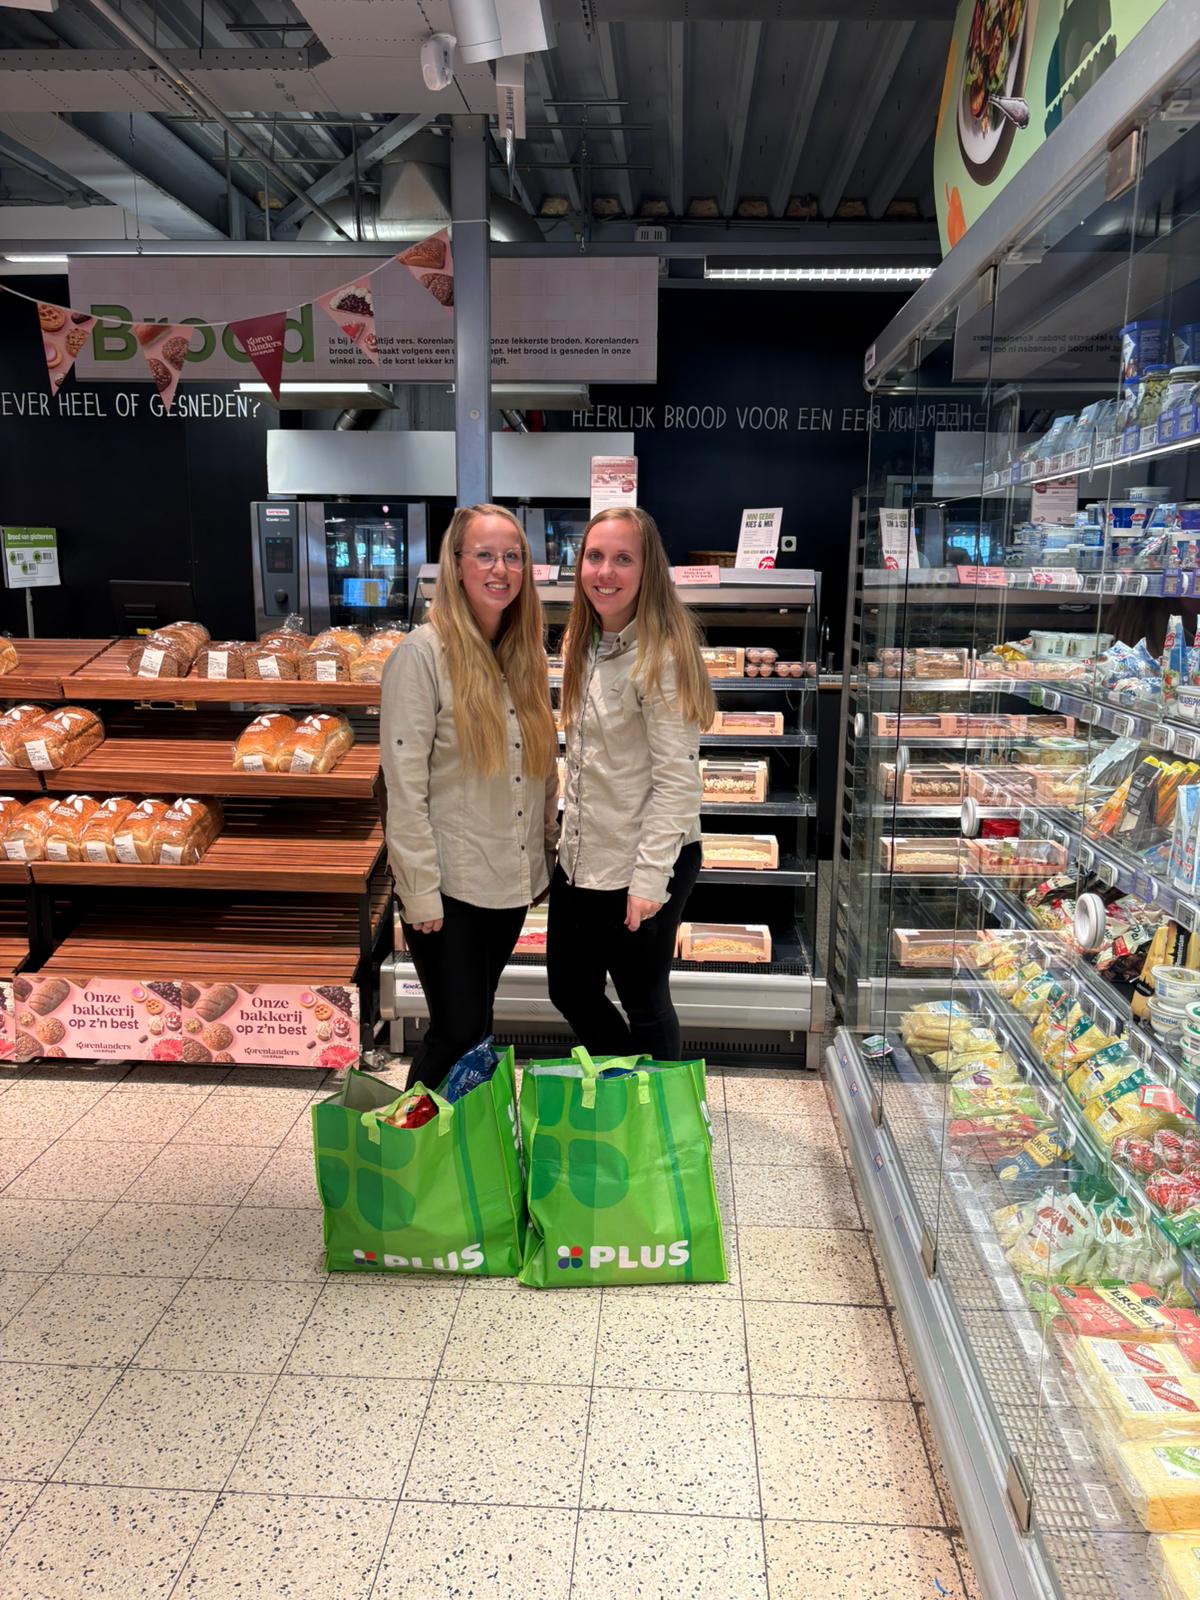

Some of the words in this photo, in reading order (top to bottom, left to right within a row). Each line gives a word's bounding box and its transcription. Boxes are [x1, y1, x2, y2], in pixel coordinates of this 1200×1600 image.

[90, 304, 315, 363] Bood
[329, 337, 335, 345] is
[337, 337, 348, 346] bij
[511, 337, 549, 345] lekkerste
[550, 337, 583, 345] broden.
[584, 337, 639, 345] Korenlanders
[329, 347, 354, 355] brood
[355, 347, 363, 355] is
[401, 347, 433, 356] volgens
[507, 347, 521, 355] Het
[523, 347, 549, 355] brood
[550, 347, 557, 355] is
[559, 347, 600, 356] gesneden
[601, 347, 609, 355] in
[329, 357, 356, 365] winkel
[382, 357, 393, 365] de
[395, 357, 416, 365] korst
[417, 357, 443, 365] lekker
[58, 393, 107, 417] HEEL
[115, 393, 140, 417] OF
[572, 404, 655, 429] HEERLIJK
[664, 405, 726, 429] BROOD
[736, 406, 788, 430] VOOR
[797, 407, 833, 431] EEN
[745, 520, 757, 528] KIES
[84, 991, 121, 1004] Onze
[251, 997, 289, 1009] Onze
[72, 1004, 135, 1019] bakkerij
[239, 1010, 303, 1024] bakkerij
[68, 1019, 86, 1030] op
[110, 1018, 139, 1030] best
[236, 1024, 254, 1036] op
[278, 1023, 308, 1036] best
[76, 1041, 132, 1051] Korenlanders
[244, 1047, 300, 1057] Korenlanders
[589, 1239, 690, 1270] PLUS
